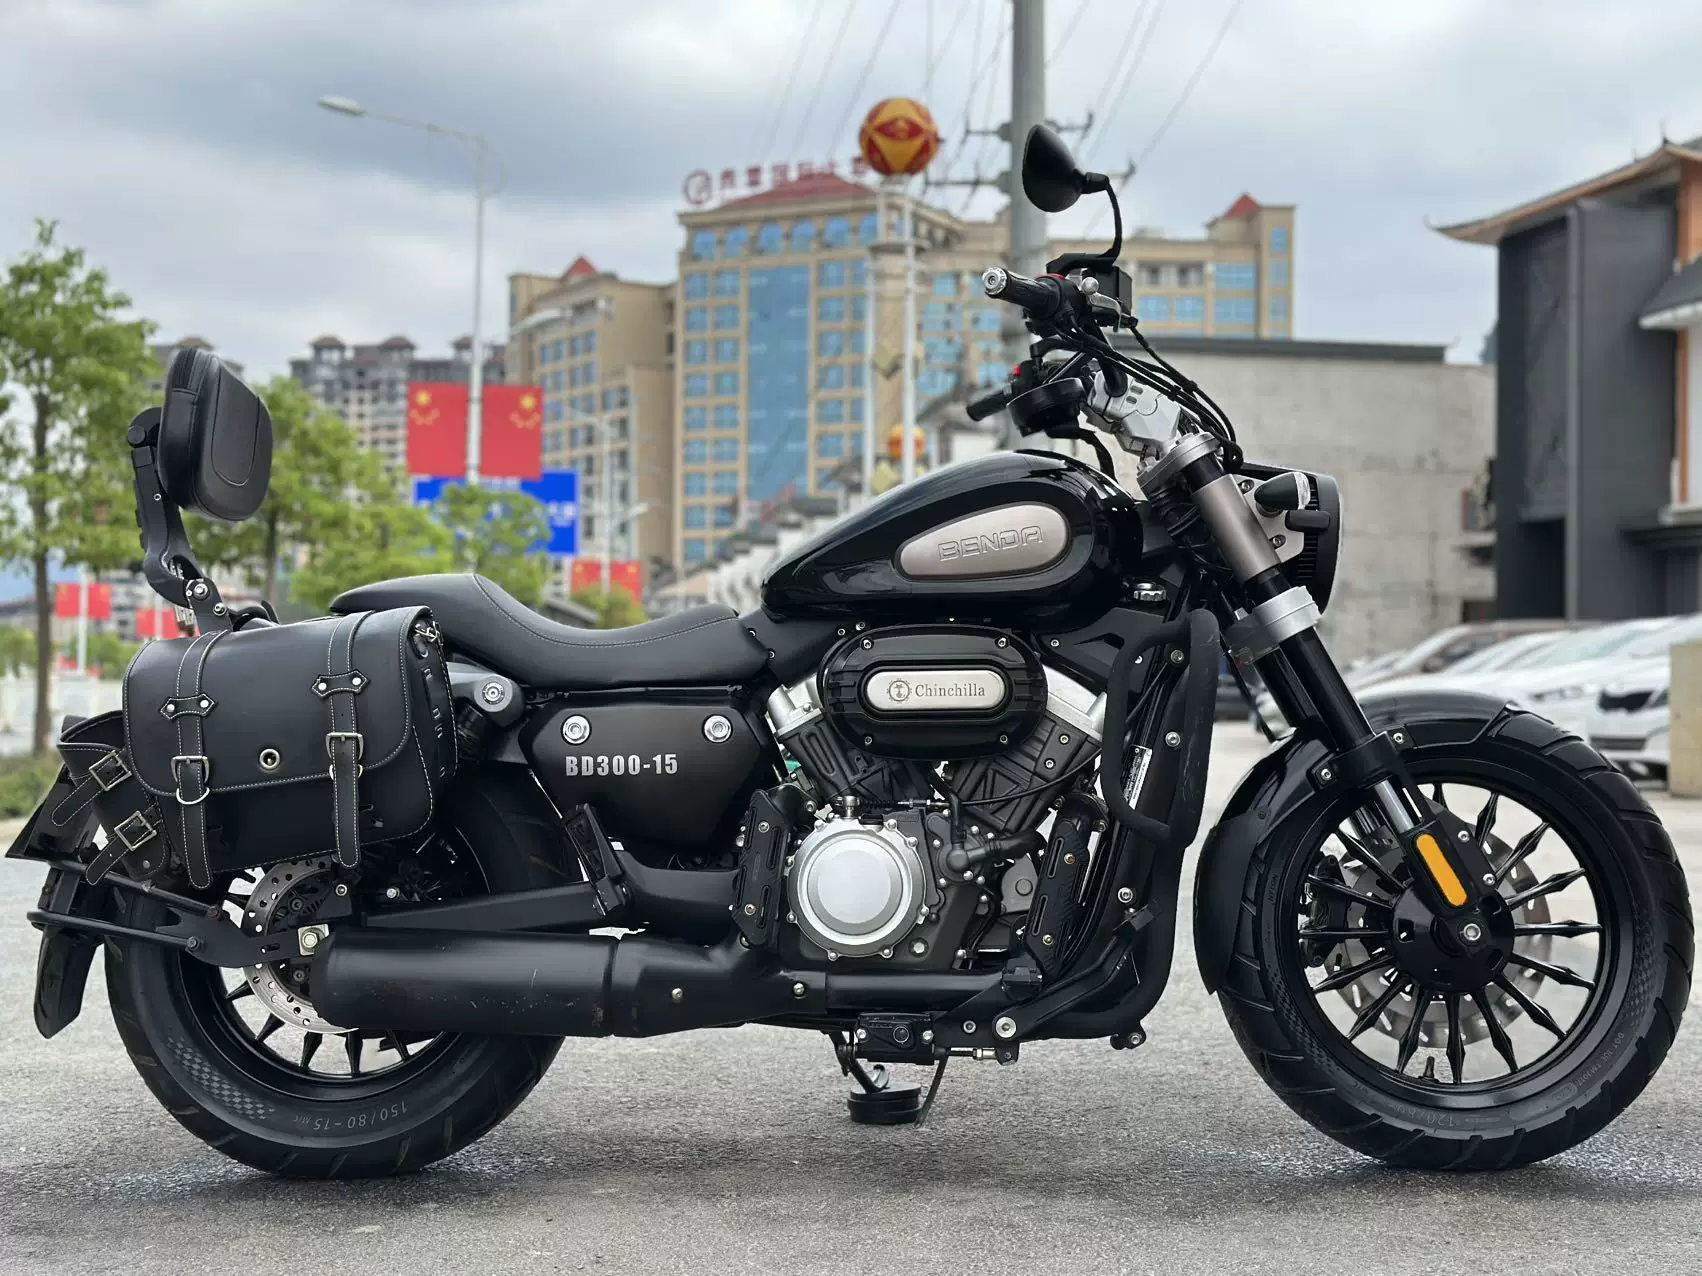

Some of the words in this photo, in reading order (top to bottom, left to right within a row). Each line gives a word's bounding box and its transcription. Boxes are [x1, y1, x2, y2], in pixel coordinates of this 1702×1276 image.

[938, 525, 1043, 561] BENDA
[915, 683, 985, 697] Chinchilla
[565, 753, 678, 776] BD300-15
